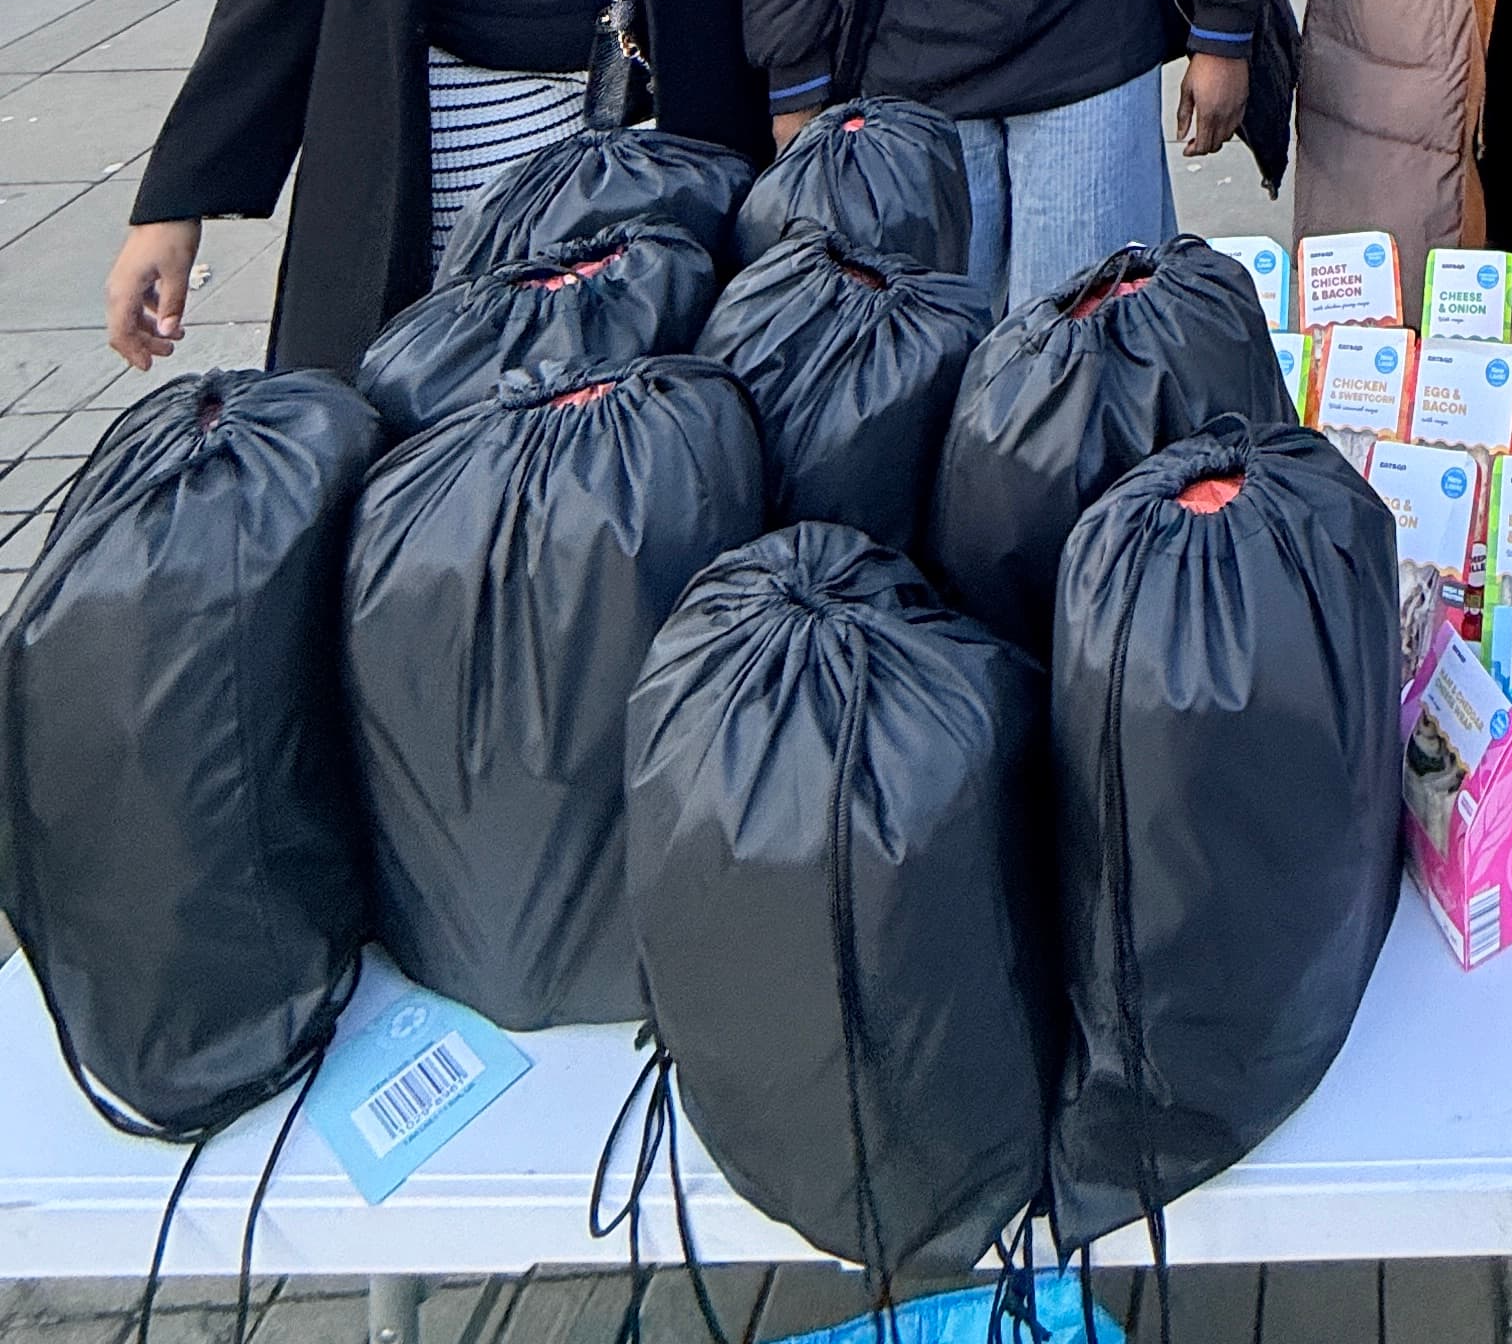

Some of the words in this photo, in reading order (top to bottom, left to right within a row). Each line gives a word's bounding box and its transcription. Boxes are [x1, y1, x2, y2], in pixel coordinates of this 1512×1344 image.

[1311, 264, 1347, 277] ROAST
[1311, 274, 1363, 289] CHICKEN
[1311, 292, 1320, 301] &
[1321, 287, 1362, 300] BACON
[1439, 291, 1483, 303] CHEESE
[1438, 303, 1446, 313] &
[1448, 304, 1487, 315] ONION
[1332, 378, 1388, 393] CHICKEN
[1337, 391, 1395, 406] SWEETCORN
[1424, 386, 1450, 400] EGG
[1452, 389, 1461, 401] &
[1422, 400, 1468, 416] BACON
[1403, 499, 1412, 512] &
